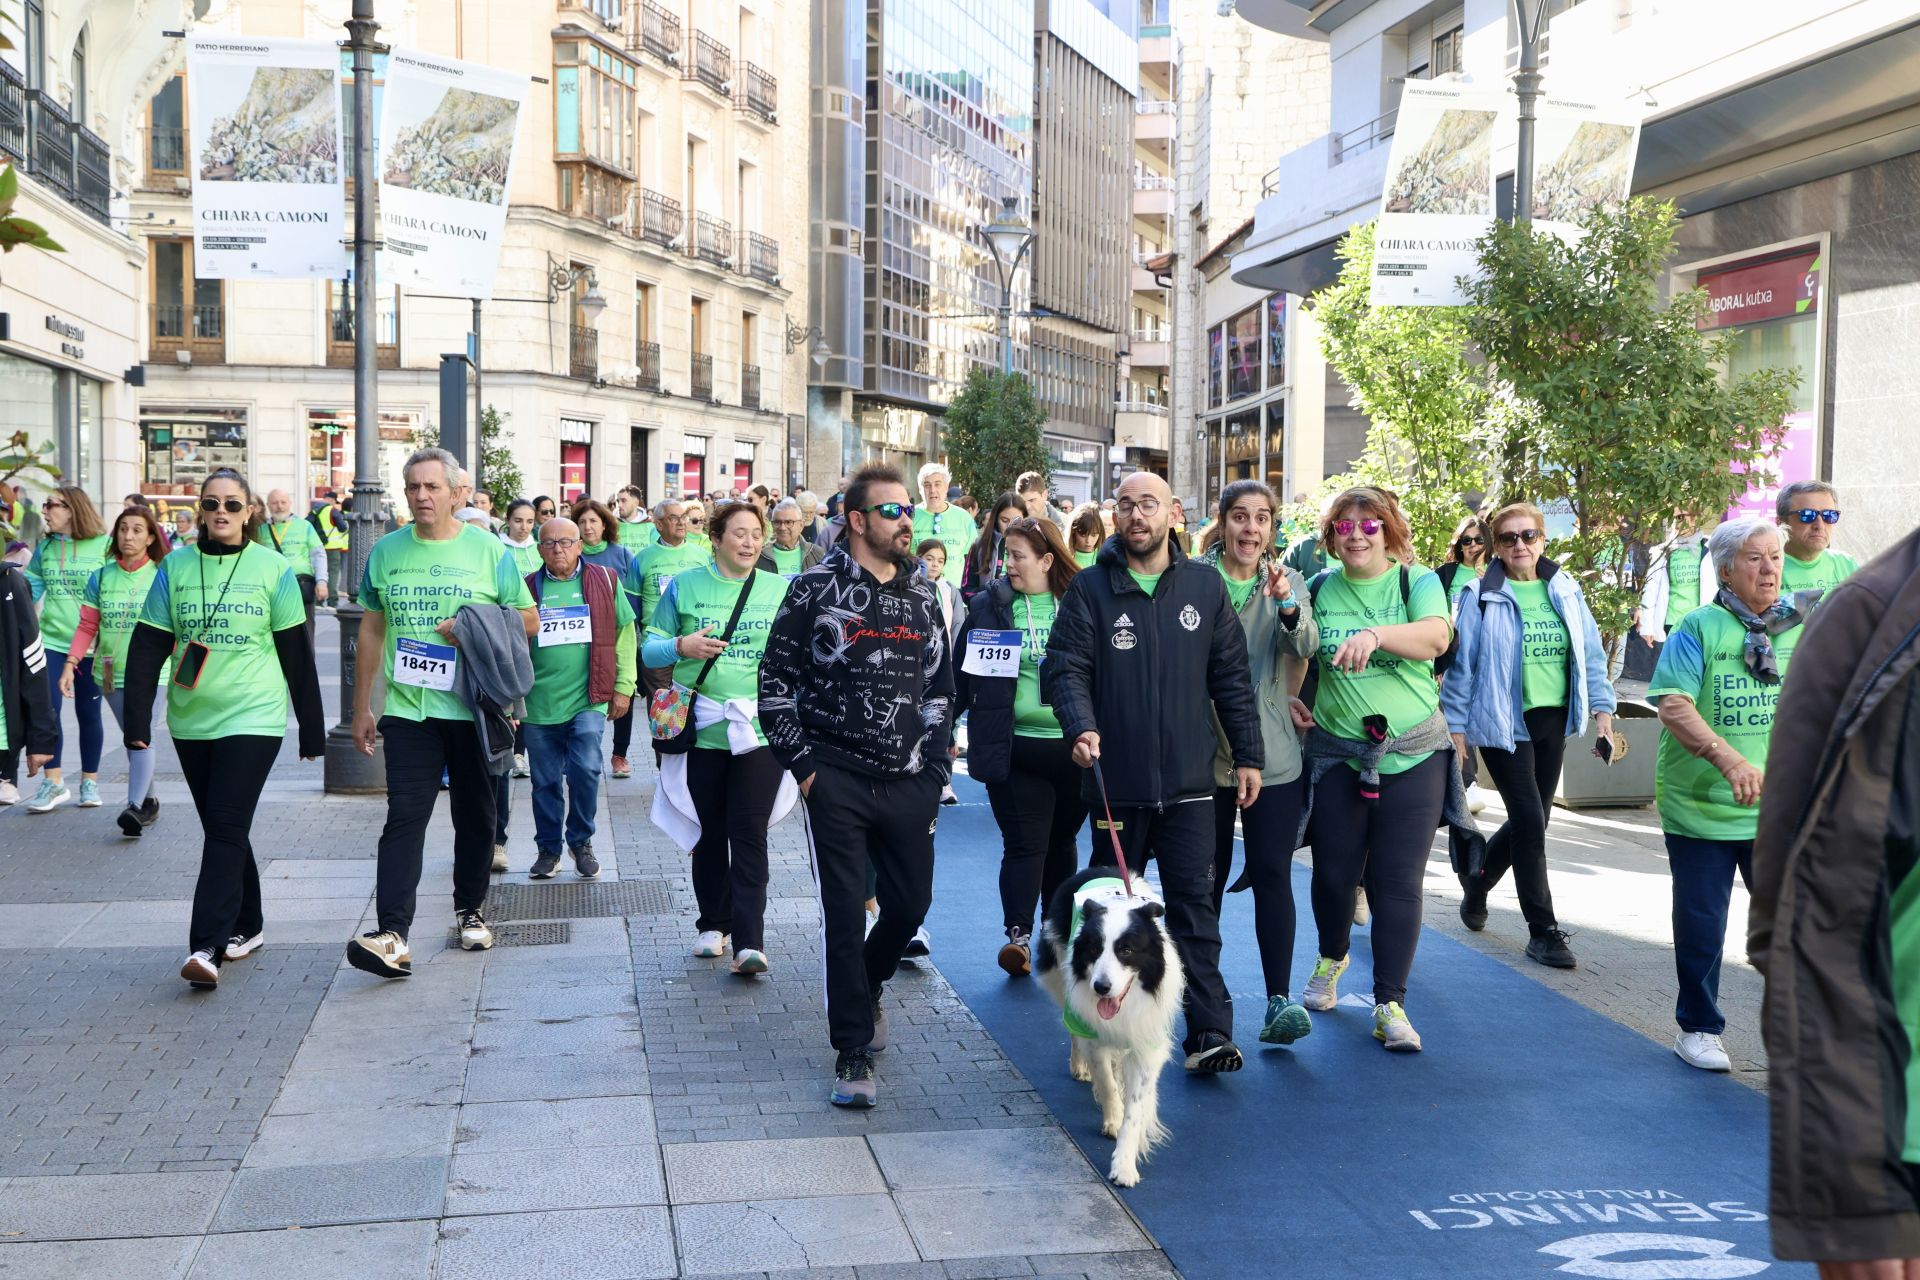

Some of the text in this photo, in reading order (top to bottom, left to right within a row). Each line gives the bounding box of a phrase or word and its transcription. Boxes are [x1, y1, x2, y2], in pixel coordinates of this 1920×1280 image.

[195, 43, 270, 53] PATIO HERRERIANO
[395, 56, 464, 77] PATIO HERRERIANO
[1408, 88, 1461, 98] PATIO HERRERIANO
[1547, 99, 1597, 111] PATIO HERRERIANO
[202, 209, 328, 223] CHIARA CAMONI
[384, 212, 427, 231] CHIARA
[430, 221, 487, 241] CAMONI
[1380, 239, 1477, 252] CHIARA CAMON
[1704, 288, 1773, 313] LABORAL kutxa
[43, 568, 94, 577] En march
[45, 578, 78, 586] contra
[390, 583, 473, 599] En marcha
[816, 573, 872, 613] NO
[102, 600, 145, 609] En marc
[181, 601, 264, 616] En marcha
[391, 599, 439, 612] contra
[102, 611, 137, 619] contra
[181, 615, 229, 629] contra
[394, 613, 448, 627] el cánc
[103, 620, 134, 629] el cán
[543, 619, 585, 633] 27152
[701, 617, 720, 630] En
[181, 630, 251, 644] el cáncer
[844, 616, 922, 646] Generation
[1320, 626, 1340, 639] En
[1523, 631, 1563, 643] ontra
[720, 647, 764, 660] cánce
[978, 647, 1011, 661] 1319
[401, 655, 447, 675] 18471
[1723, 674, 1748, 690] En
[1713, 674, 1721, 727] VALLADOLID
[1723, 710, 1743, 727] el
[1449, 1189, 1684, 1204] VALLADOLID
[1408, 1201, 1769, 1231] SEMINCI
